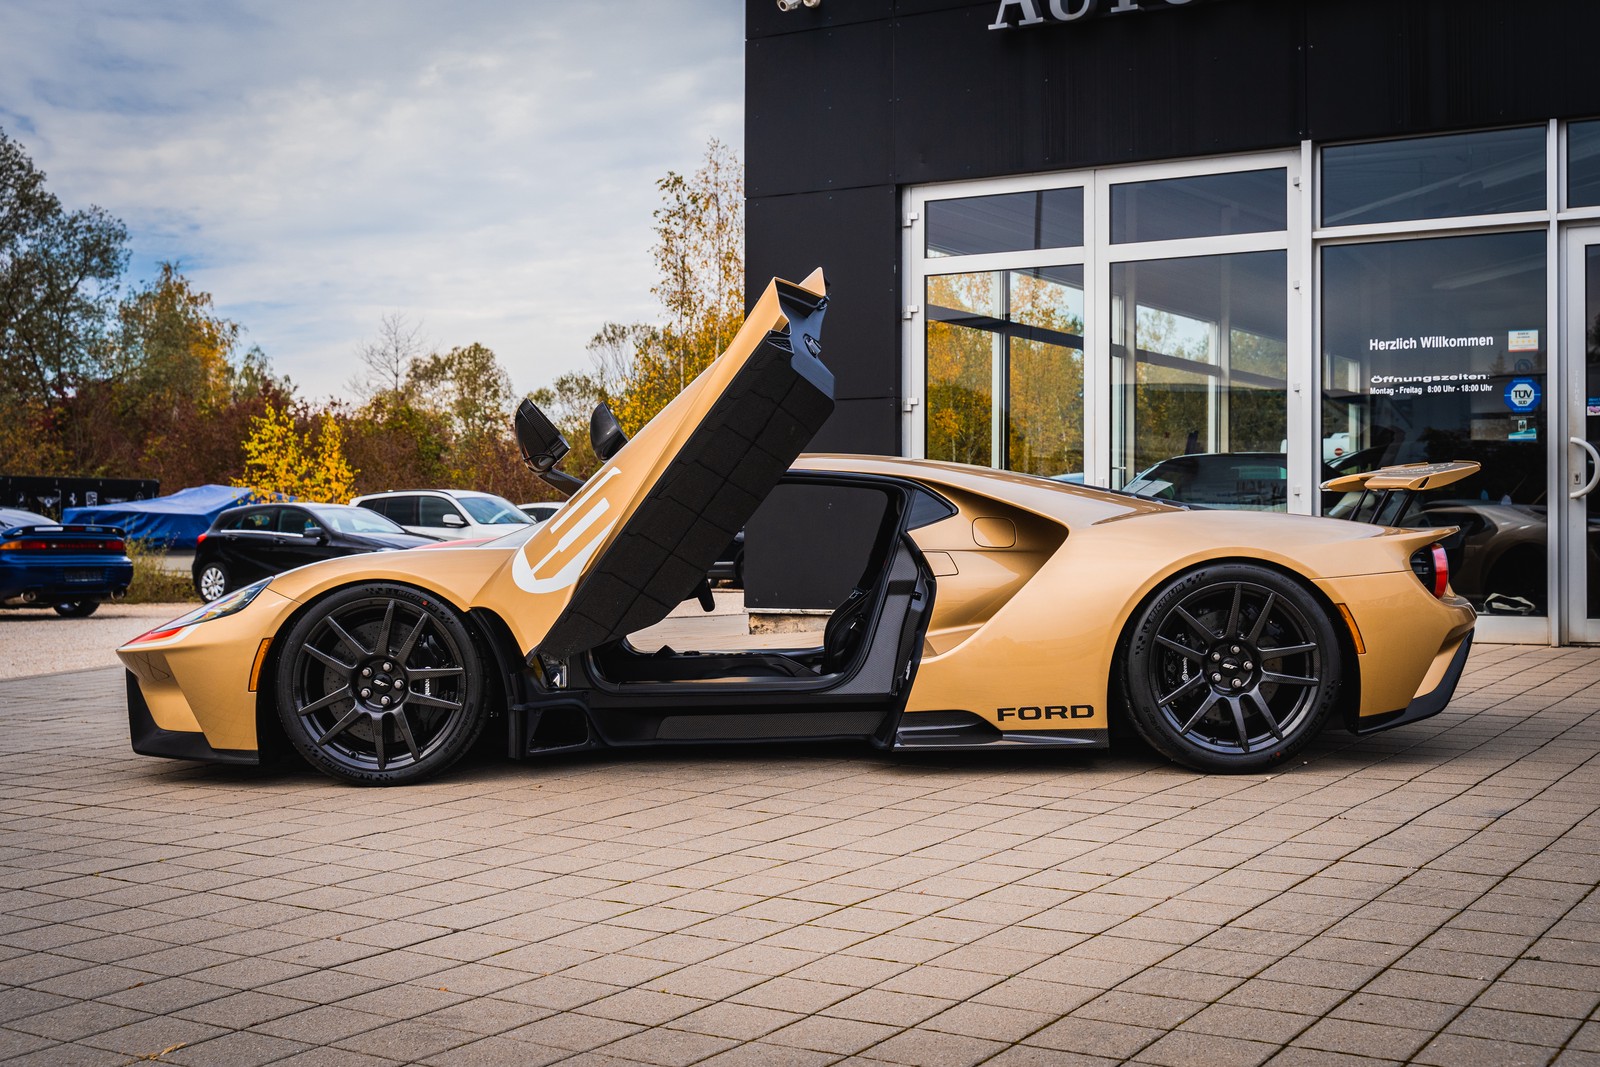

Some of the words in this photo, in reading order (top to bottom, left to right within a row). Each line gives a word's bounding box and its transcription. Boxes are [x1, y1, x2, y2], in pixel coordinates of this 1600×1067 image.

[1369, 338, 1416, 350] Herzlich
[1420, 336, 1494, 348] Willkommen
[1370, 374, 1490, 384] Öffnungszeiten:
[1370, 386, 1394, 396] Montag
[1400, 386, 1422, 395] Freitag
[1146, 582, 1184, 622] MICHELIN
[997, 704, 1094, 721] FORD
